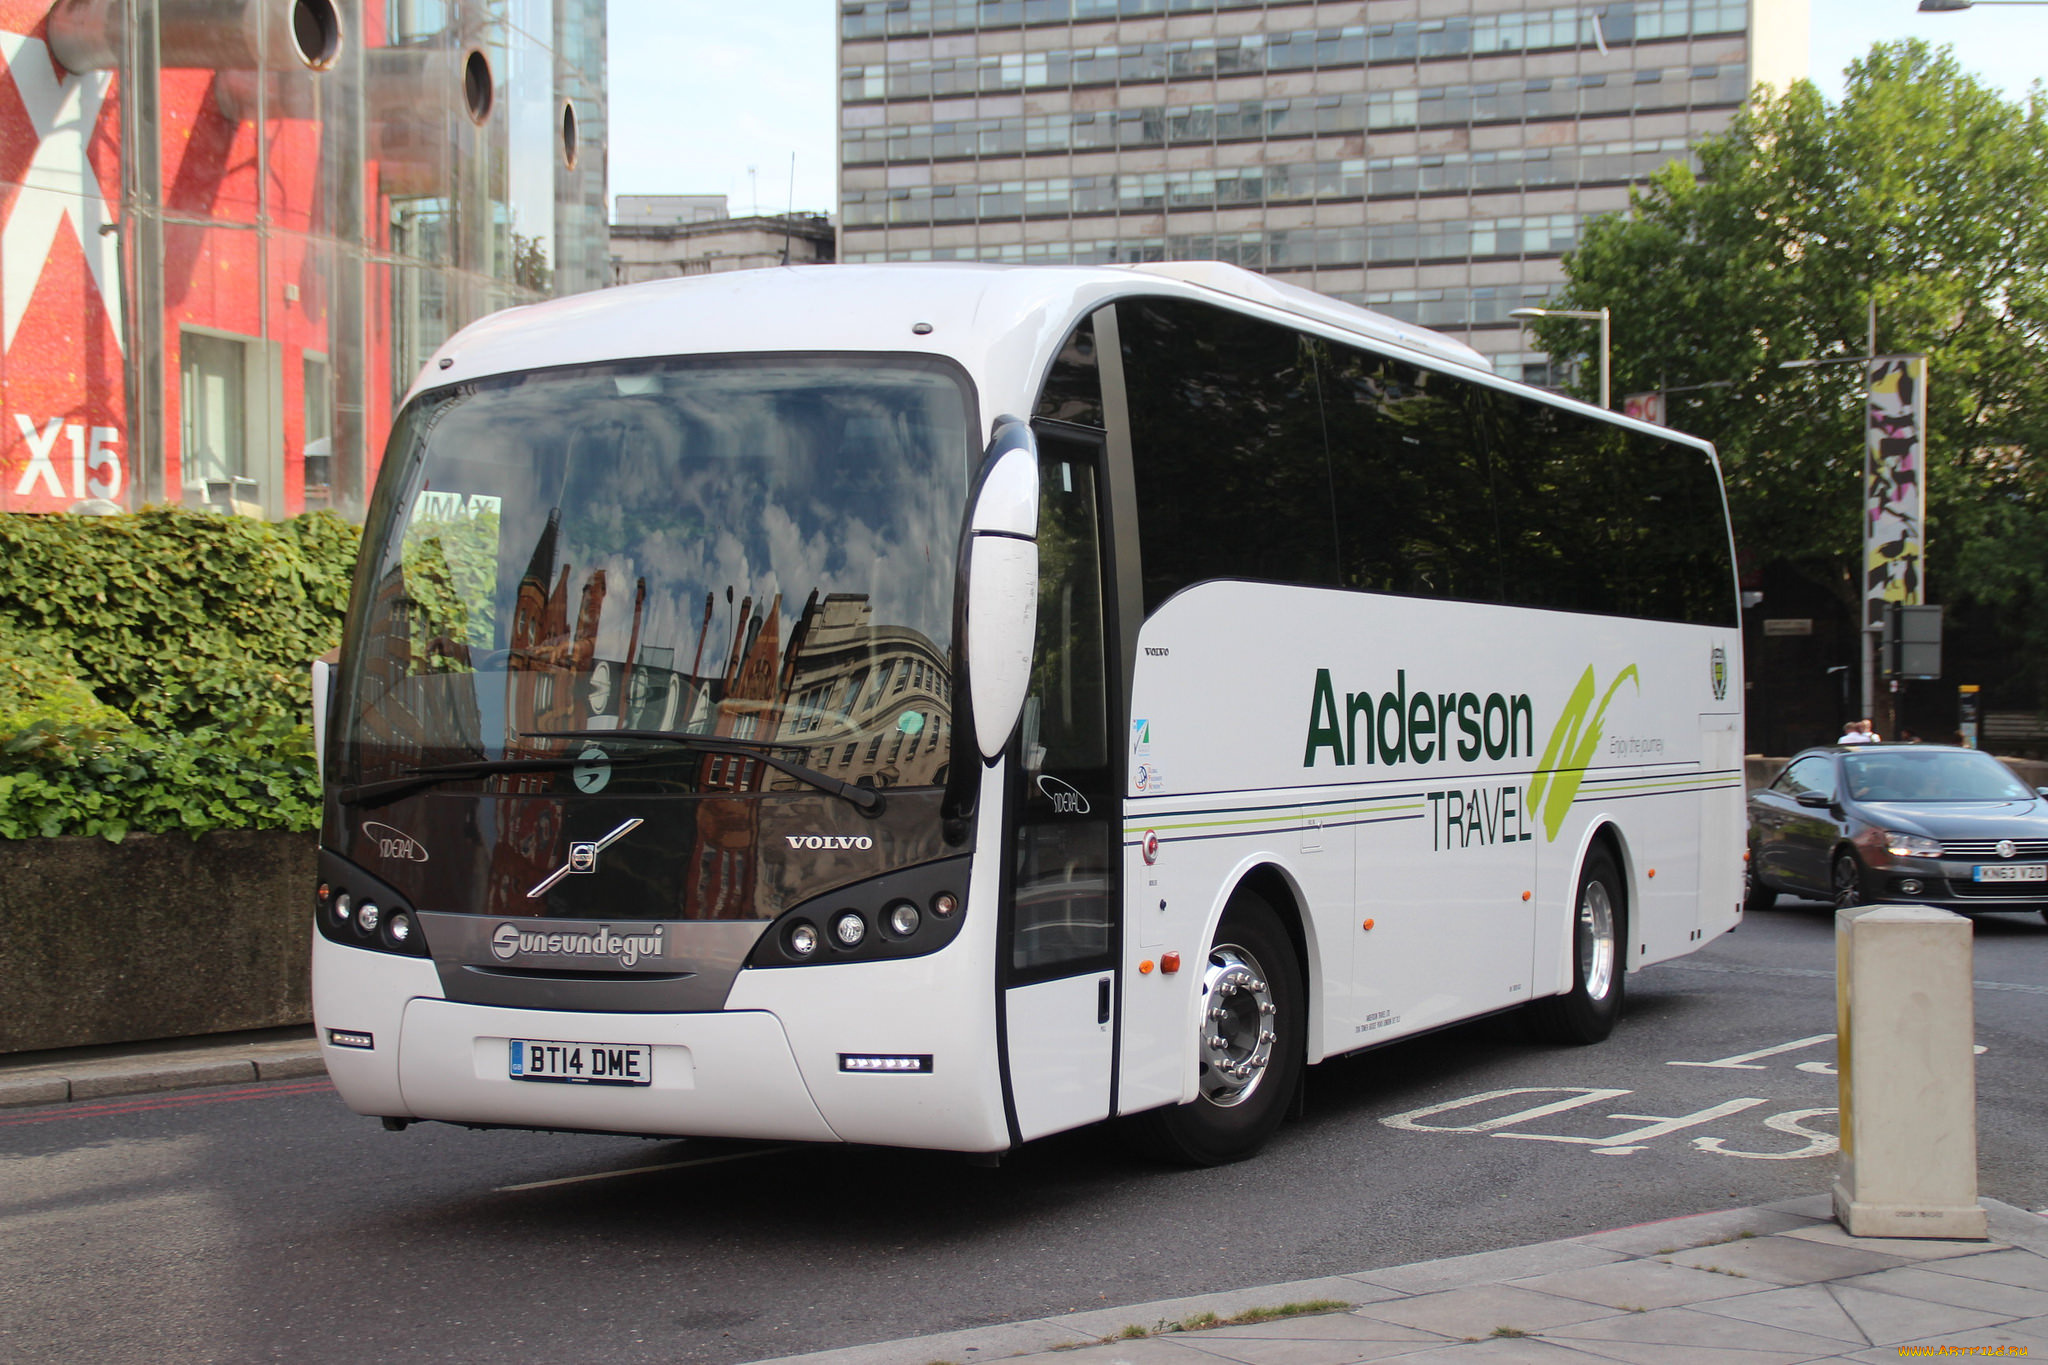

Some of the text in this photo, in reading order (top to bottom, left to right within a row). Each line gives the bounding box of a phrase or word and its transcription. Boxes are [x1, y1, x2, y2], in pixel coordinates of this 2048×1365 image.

[13, 413, 122, 499] X15
[1144, 647, 1170, 656] VOLVO
[1303, 668, 1533, 767] Anderson
[1427, 786, 1532, 851] TRAVEL
[785, 835, 873, 850] VOLVO
[492, 922, 664, 967] Sunsundegui
[530, 1045, 640, 1077] BT14 DME
